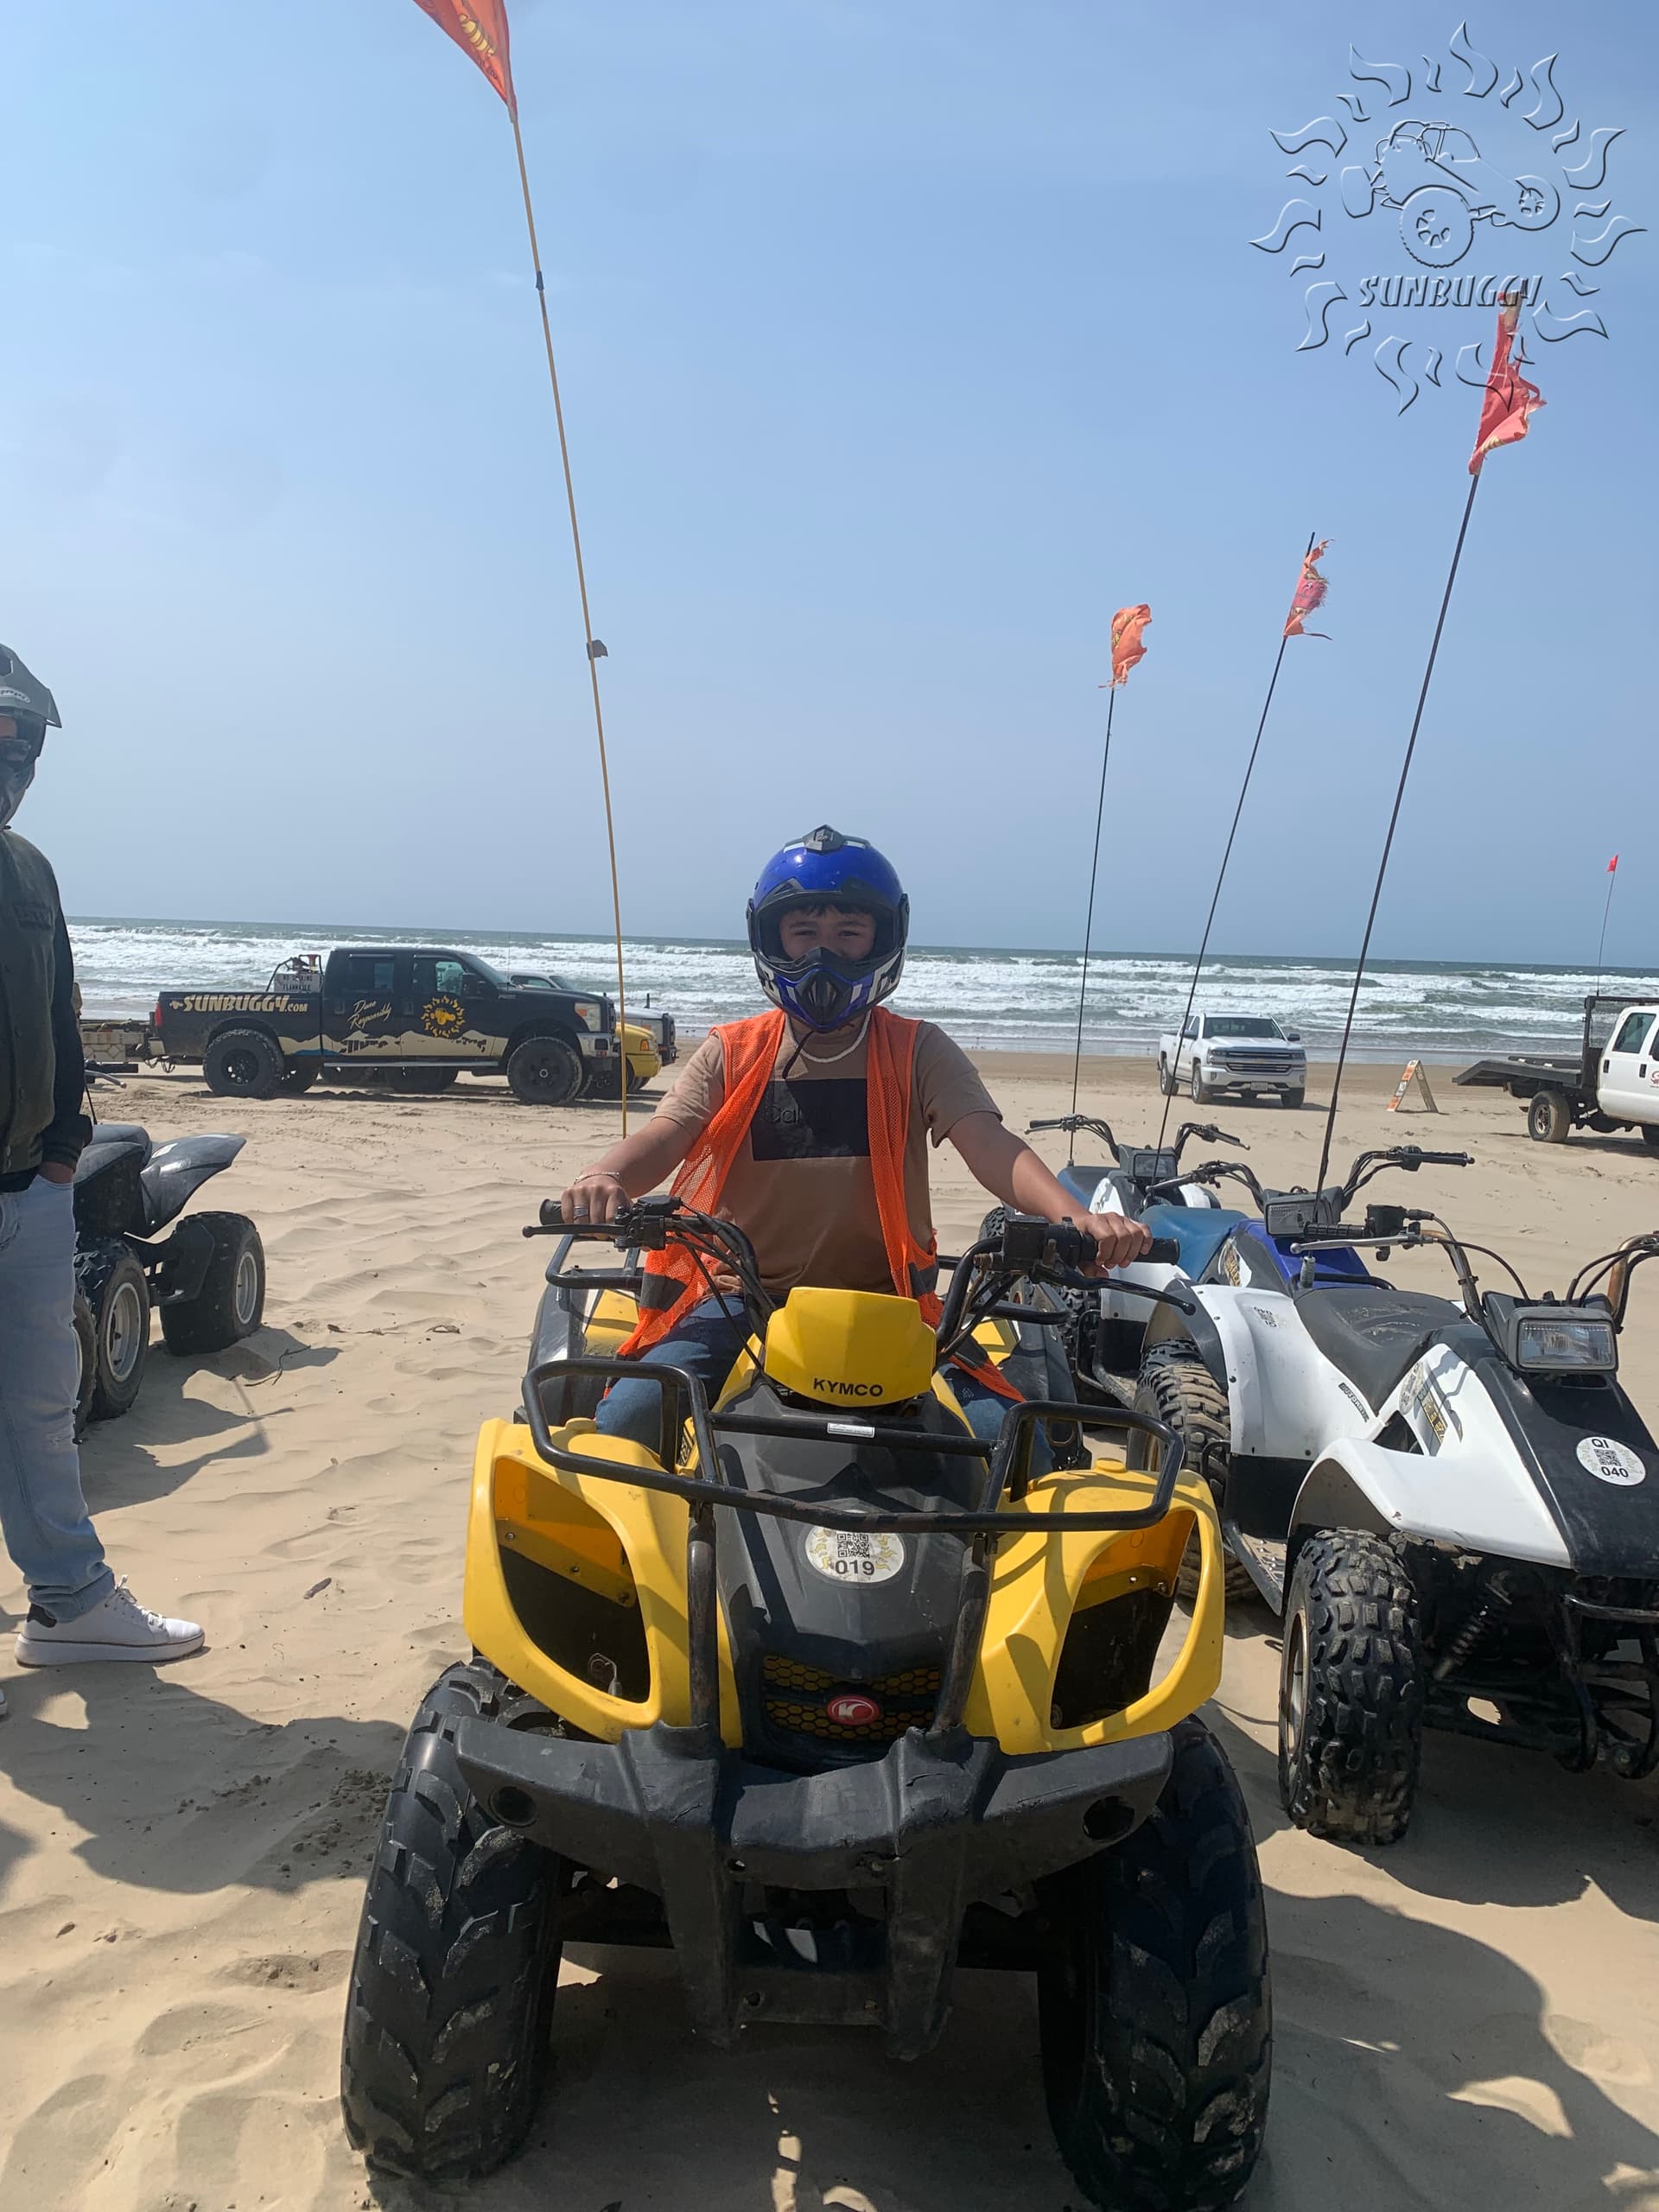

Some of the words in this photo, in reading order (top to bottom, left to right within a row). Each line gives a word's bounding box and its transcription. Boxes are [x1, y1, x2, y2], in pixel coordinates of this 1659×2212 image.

[813, 1377, 884, 1397] KYMCO
[1601, 1466, 1629, 1478] 040
[835, 1560, 874, 1575] 019
